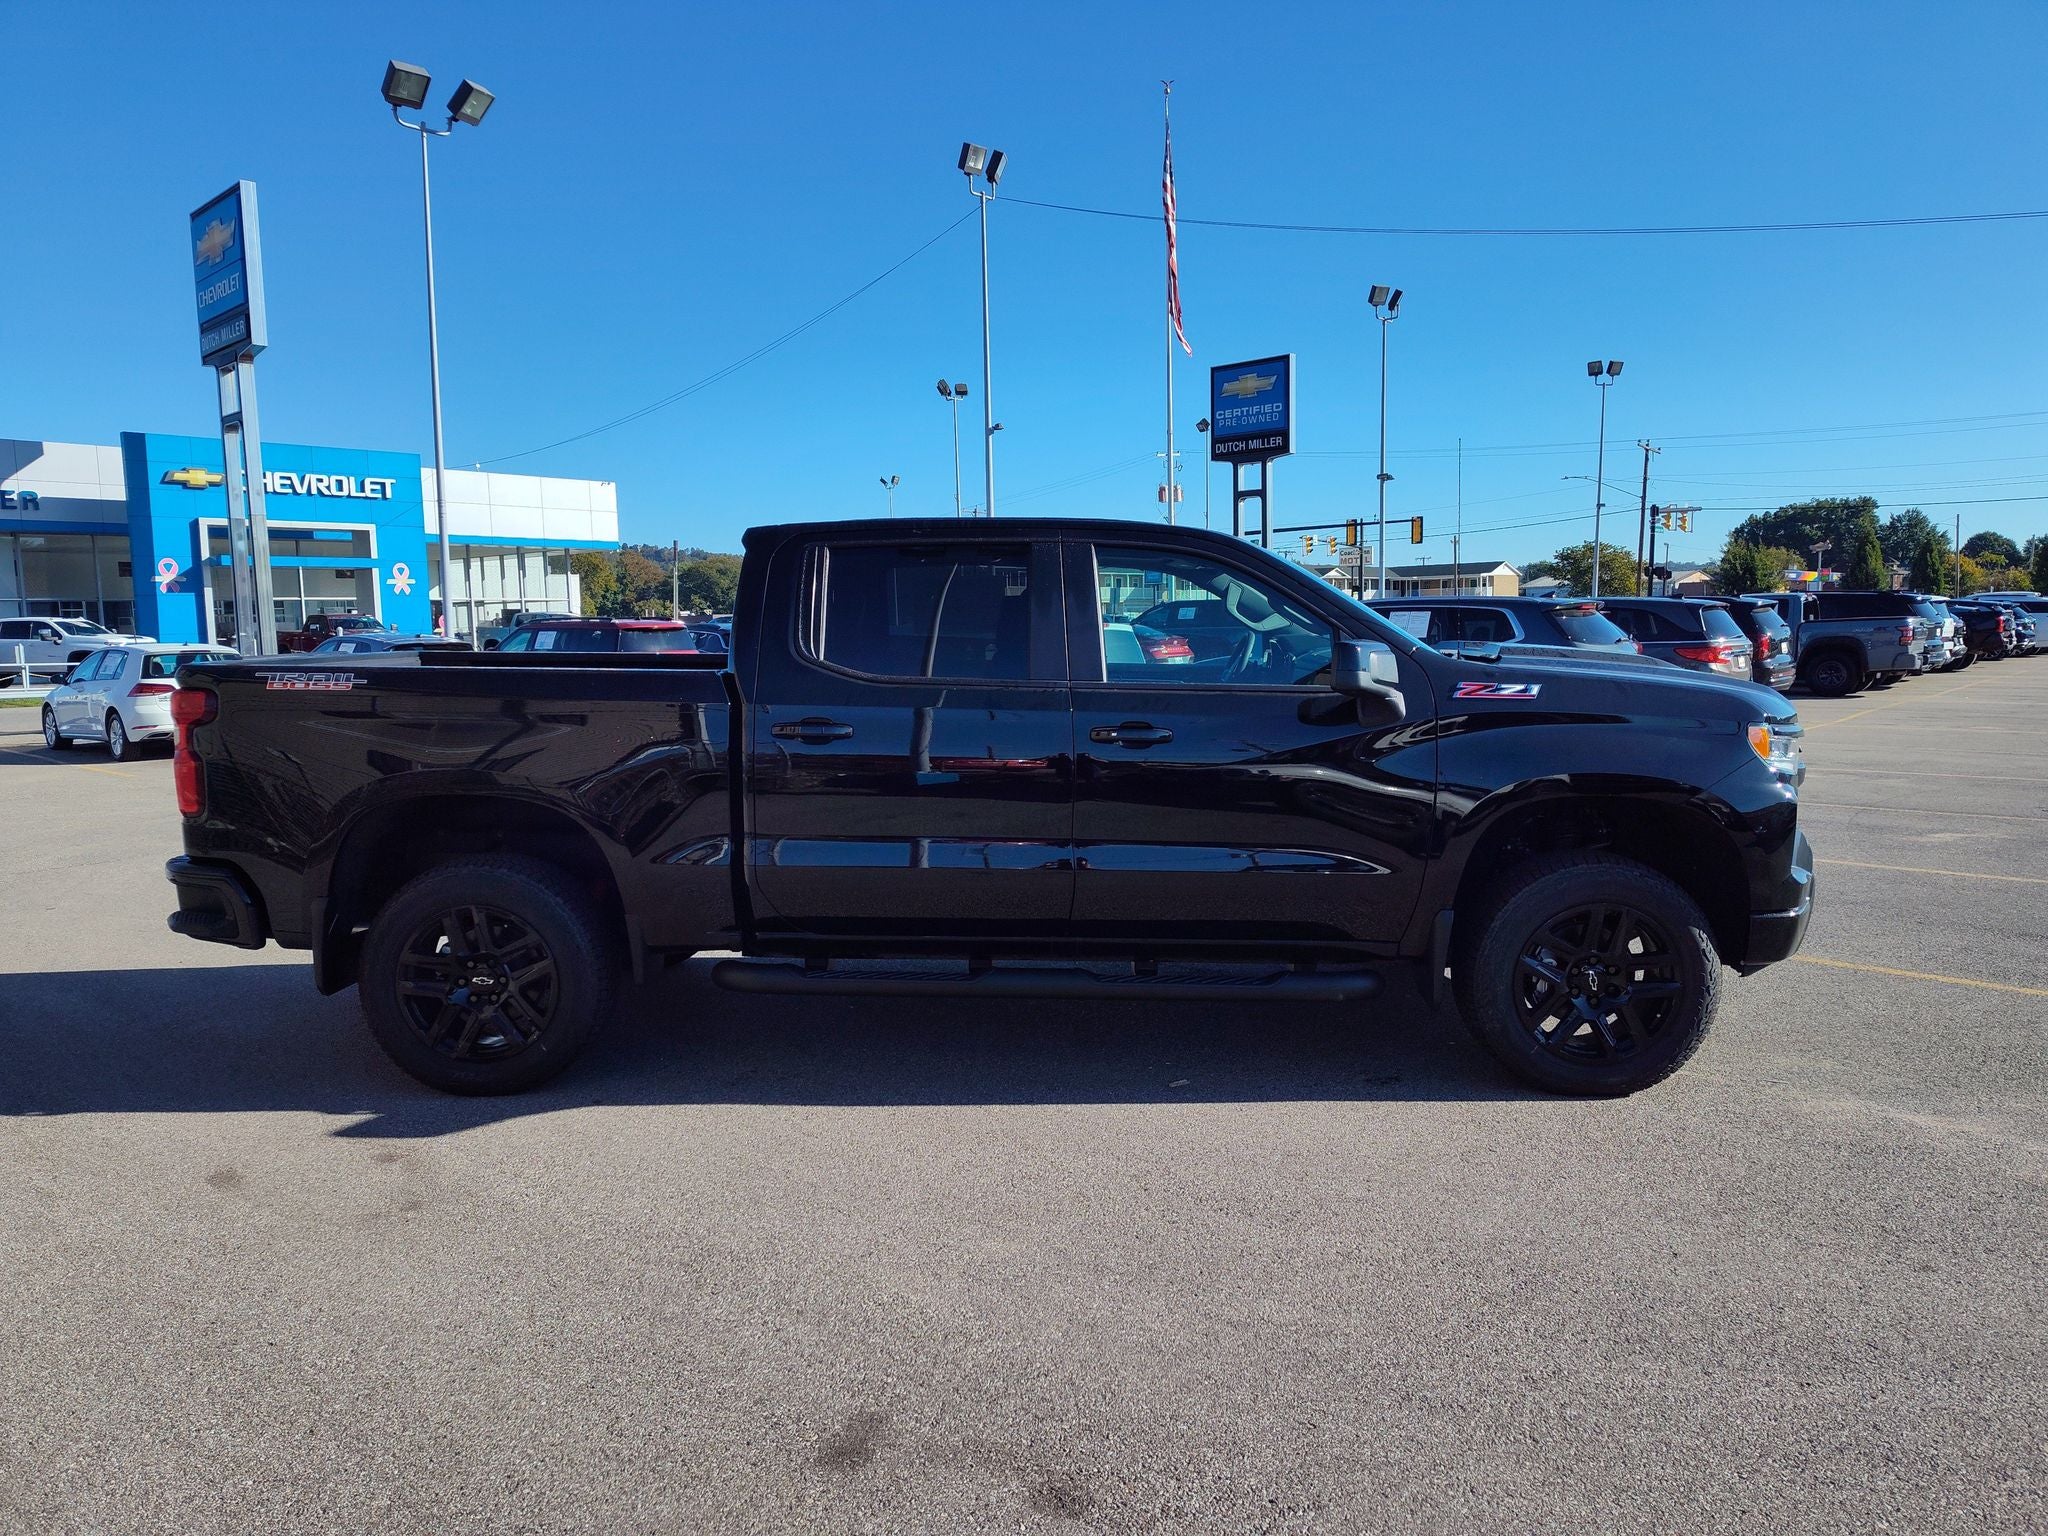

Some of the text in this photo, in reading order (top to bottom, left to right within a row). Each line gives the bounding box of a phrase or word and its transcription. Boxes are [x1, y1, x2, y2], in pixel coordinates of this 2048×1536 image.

[198, 272, 240, 308] CHEVROLET
[201, 320, 246, 351] DUTCH MILLER
[1216, 402, 1283, 419] CERTIFIED
[1218, 412, 1279, 428] PRE-OWNED
[1215, 436, 1283, 454] DUTCH MILLER
[1340, 556, 1370, 565] MOTL
[255, 672, 368, 684] TRAIL
[266, 681, 353, 691] BOSS
[1452, 681, 1543, 700] Z71
